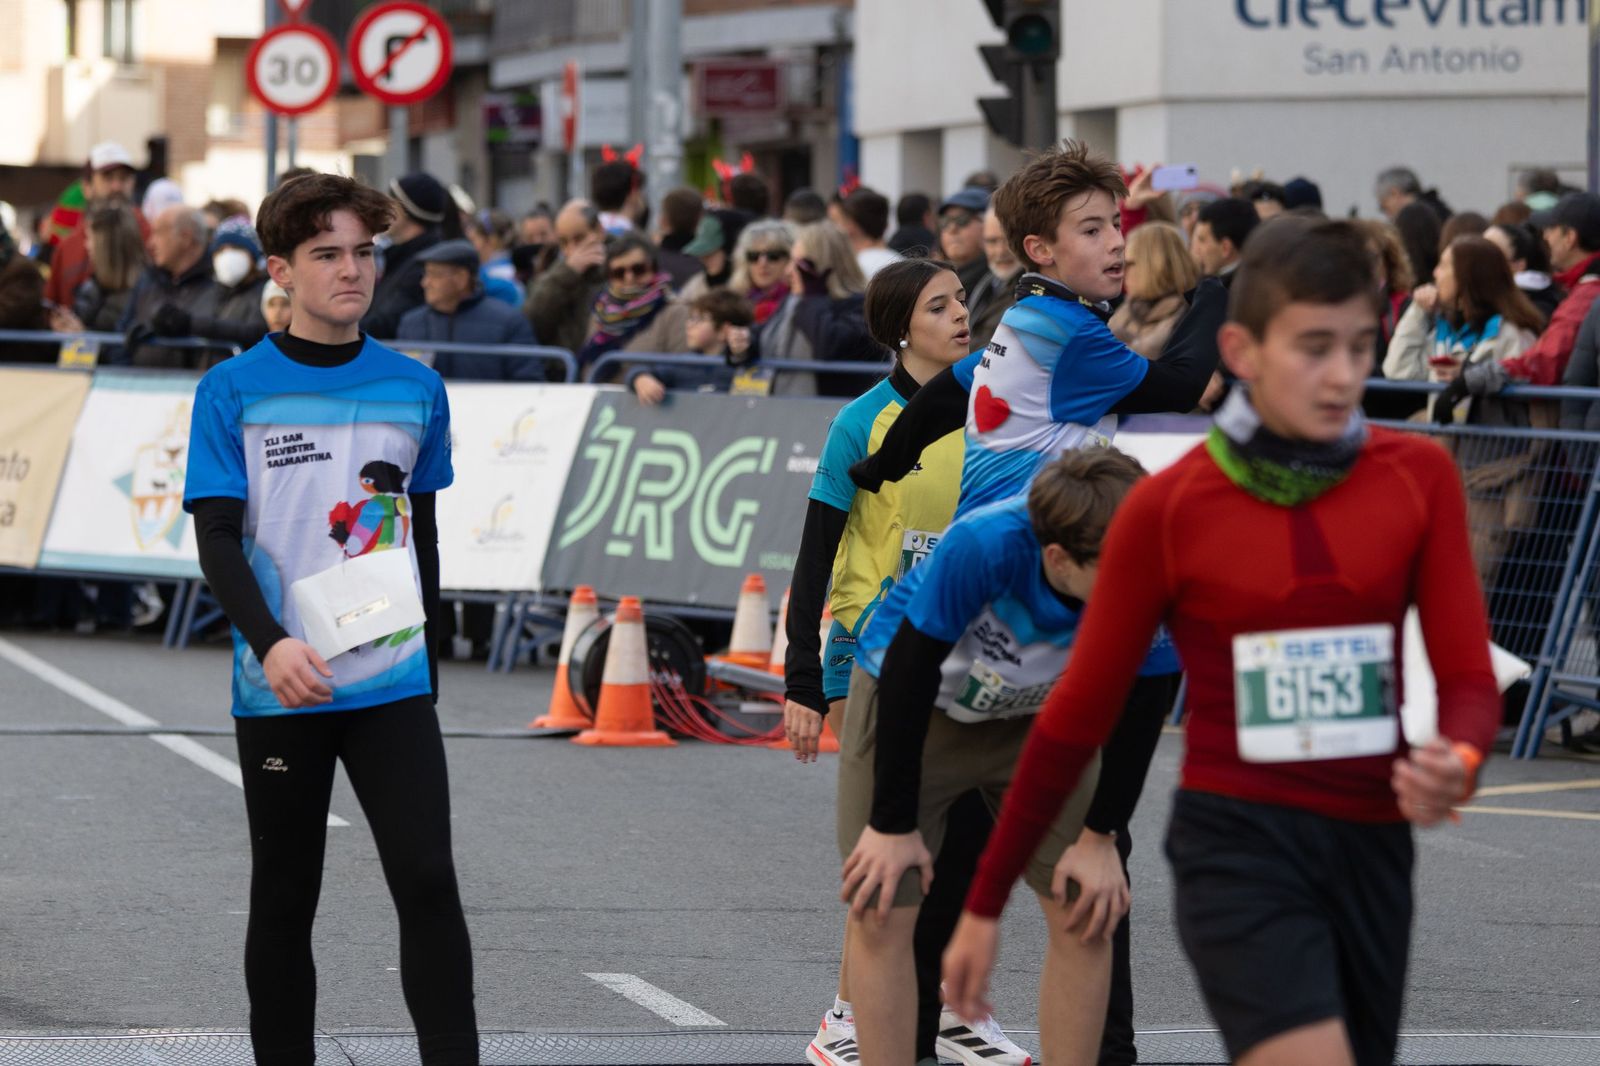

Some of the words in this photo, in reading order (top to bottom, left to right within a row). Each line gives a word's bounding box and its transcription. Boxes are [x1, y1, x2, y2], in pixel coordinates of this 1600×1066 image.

[268, 54, 320, 88] 30
[1303, 44, 1370, 75] San
[1380, 44, 1523, 74] Antonio
[264, 437, 280, 448] XLI
[282, 433, 303, 443] SAN
[265, 442, 316, 458] SILVESTRE
[267, 452, 333, 468] SALMANTINA
[1266, 665, 1364, 719] 6153
